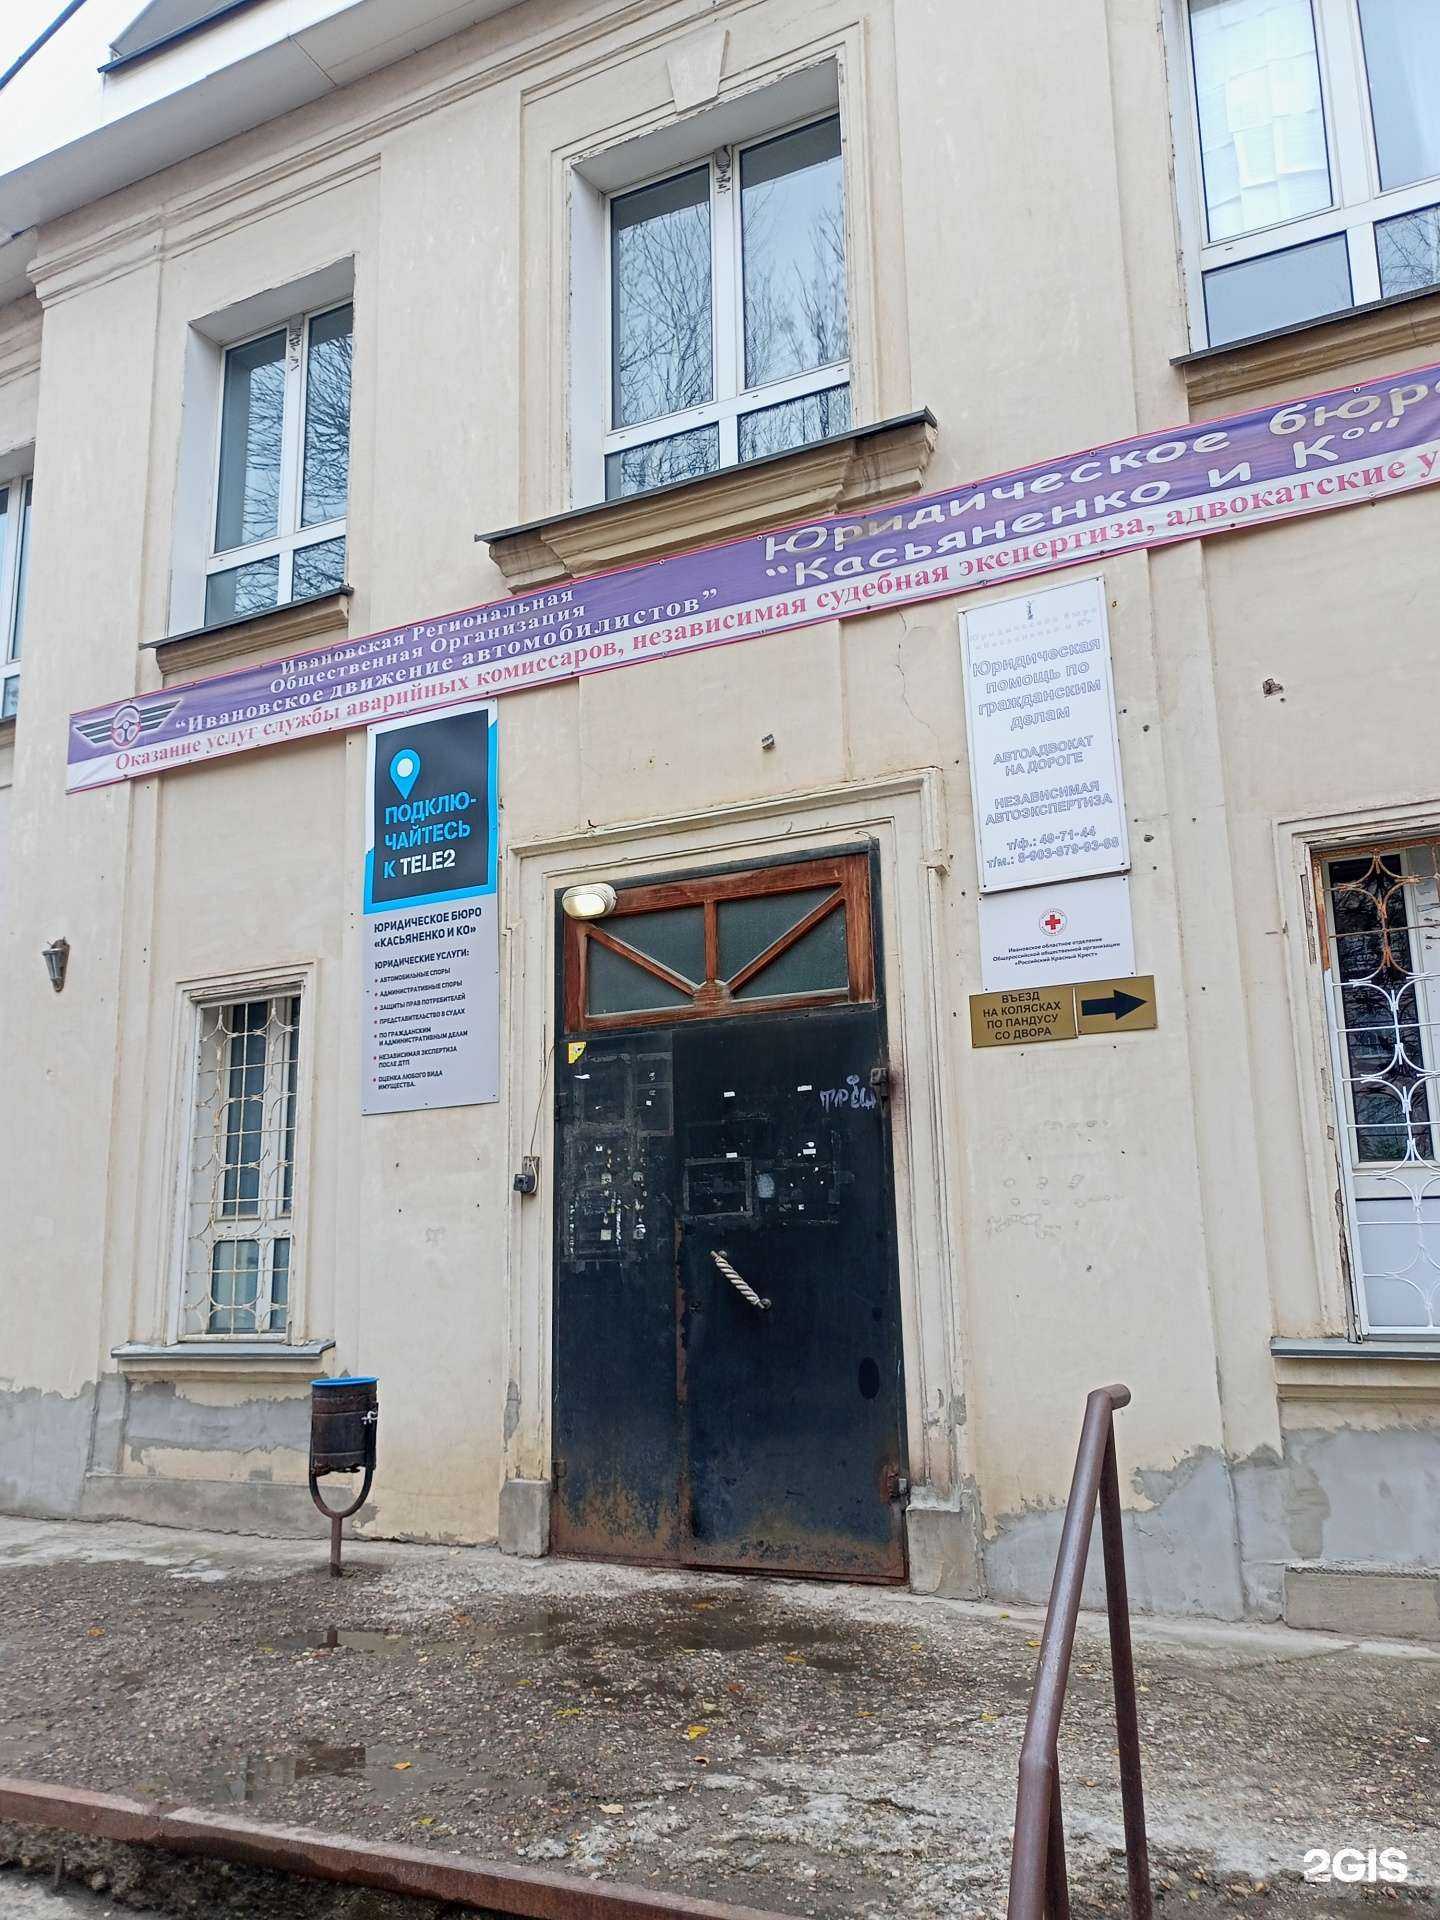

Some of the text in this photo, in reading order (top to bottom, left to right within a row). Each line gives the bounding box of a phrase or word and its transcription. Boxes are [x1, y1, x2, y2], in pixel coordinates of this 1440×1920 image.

[765, 380, 1440, 561] Юридическое бюр
[1207, 461, 1251, 488] и
[115, 740, 201, 770] Оказание
[207, 726, 255, 754] услуг
[263, 706, 339, 736] службы
[346, 677, 469, 717] аварийных
[477, 642, 624, 686] комиссаров,
[632, 598, 807, 650] независимая
[817, 565, 949, 610] судебная
[959, 518, 1155, 577] экспертиза,
[1166, 461, 1406, 528] адвокатские
[281, 590, 573, 675] Ивановская Региональная
[270, 605, 585, 694] Общественная Организация
[972, 638, 1101, 677] Юридическая
[330, 657, 453, 700] движение
[986, 661, 1090, 694] помощь по
[978, 679, 1101, 717] гражданским
[1010, 706, 1070, 731] делам
[993, 735, 1094, 765] АВТОАДВОКАТ
[1005, 751, 1084, 776] НА ДОРОГЕ
[385, 791, 476, 825] ПОДКЛЮ-
[985, 793, 1113, 825] АВТОЭКСПЕРТИЗА
[994, 780, 1100, 809] НЕЗАВИСИМАЯ
[384, 820, 471, 851] ЧАЙТЕСЬ
[383, 848, 456, 878] К TELE2
[374, 907, 482, 934] ЮРИДИЧЕСКОЕ БЮРО
[374, 923, 477, 948] «КАСЬЯНЕНКО И КО»
[374, 949, 470, 970] ЮРИДИЧЕСКИЕ УСЛУГИ:
[983, 1001, 1061, 1018] НА КОЛЯСКАХ
[1002, 991, 1040, 1004] ВЪЕЗД
[986, 1013, 1059, 1029] ПО ПАНДУСУ
[995, 1027, 1052, 1040] СО ДВОРА
